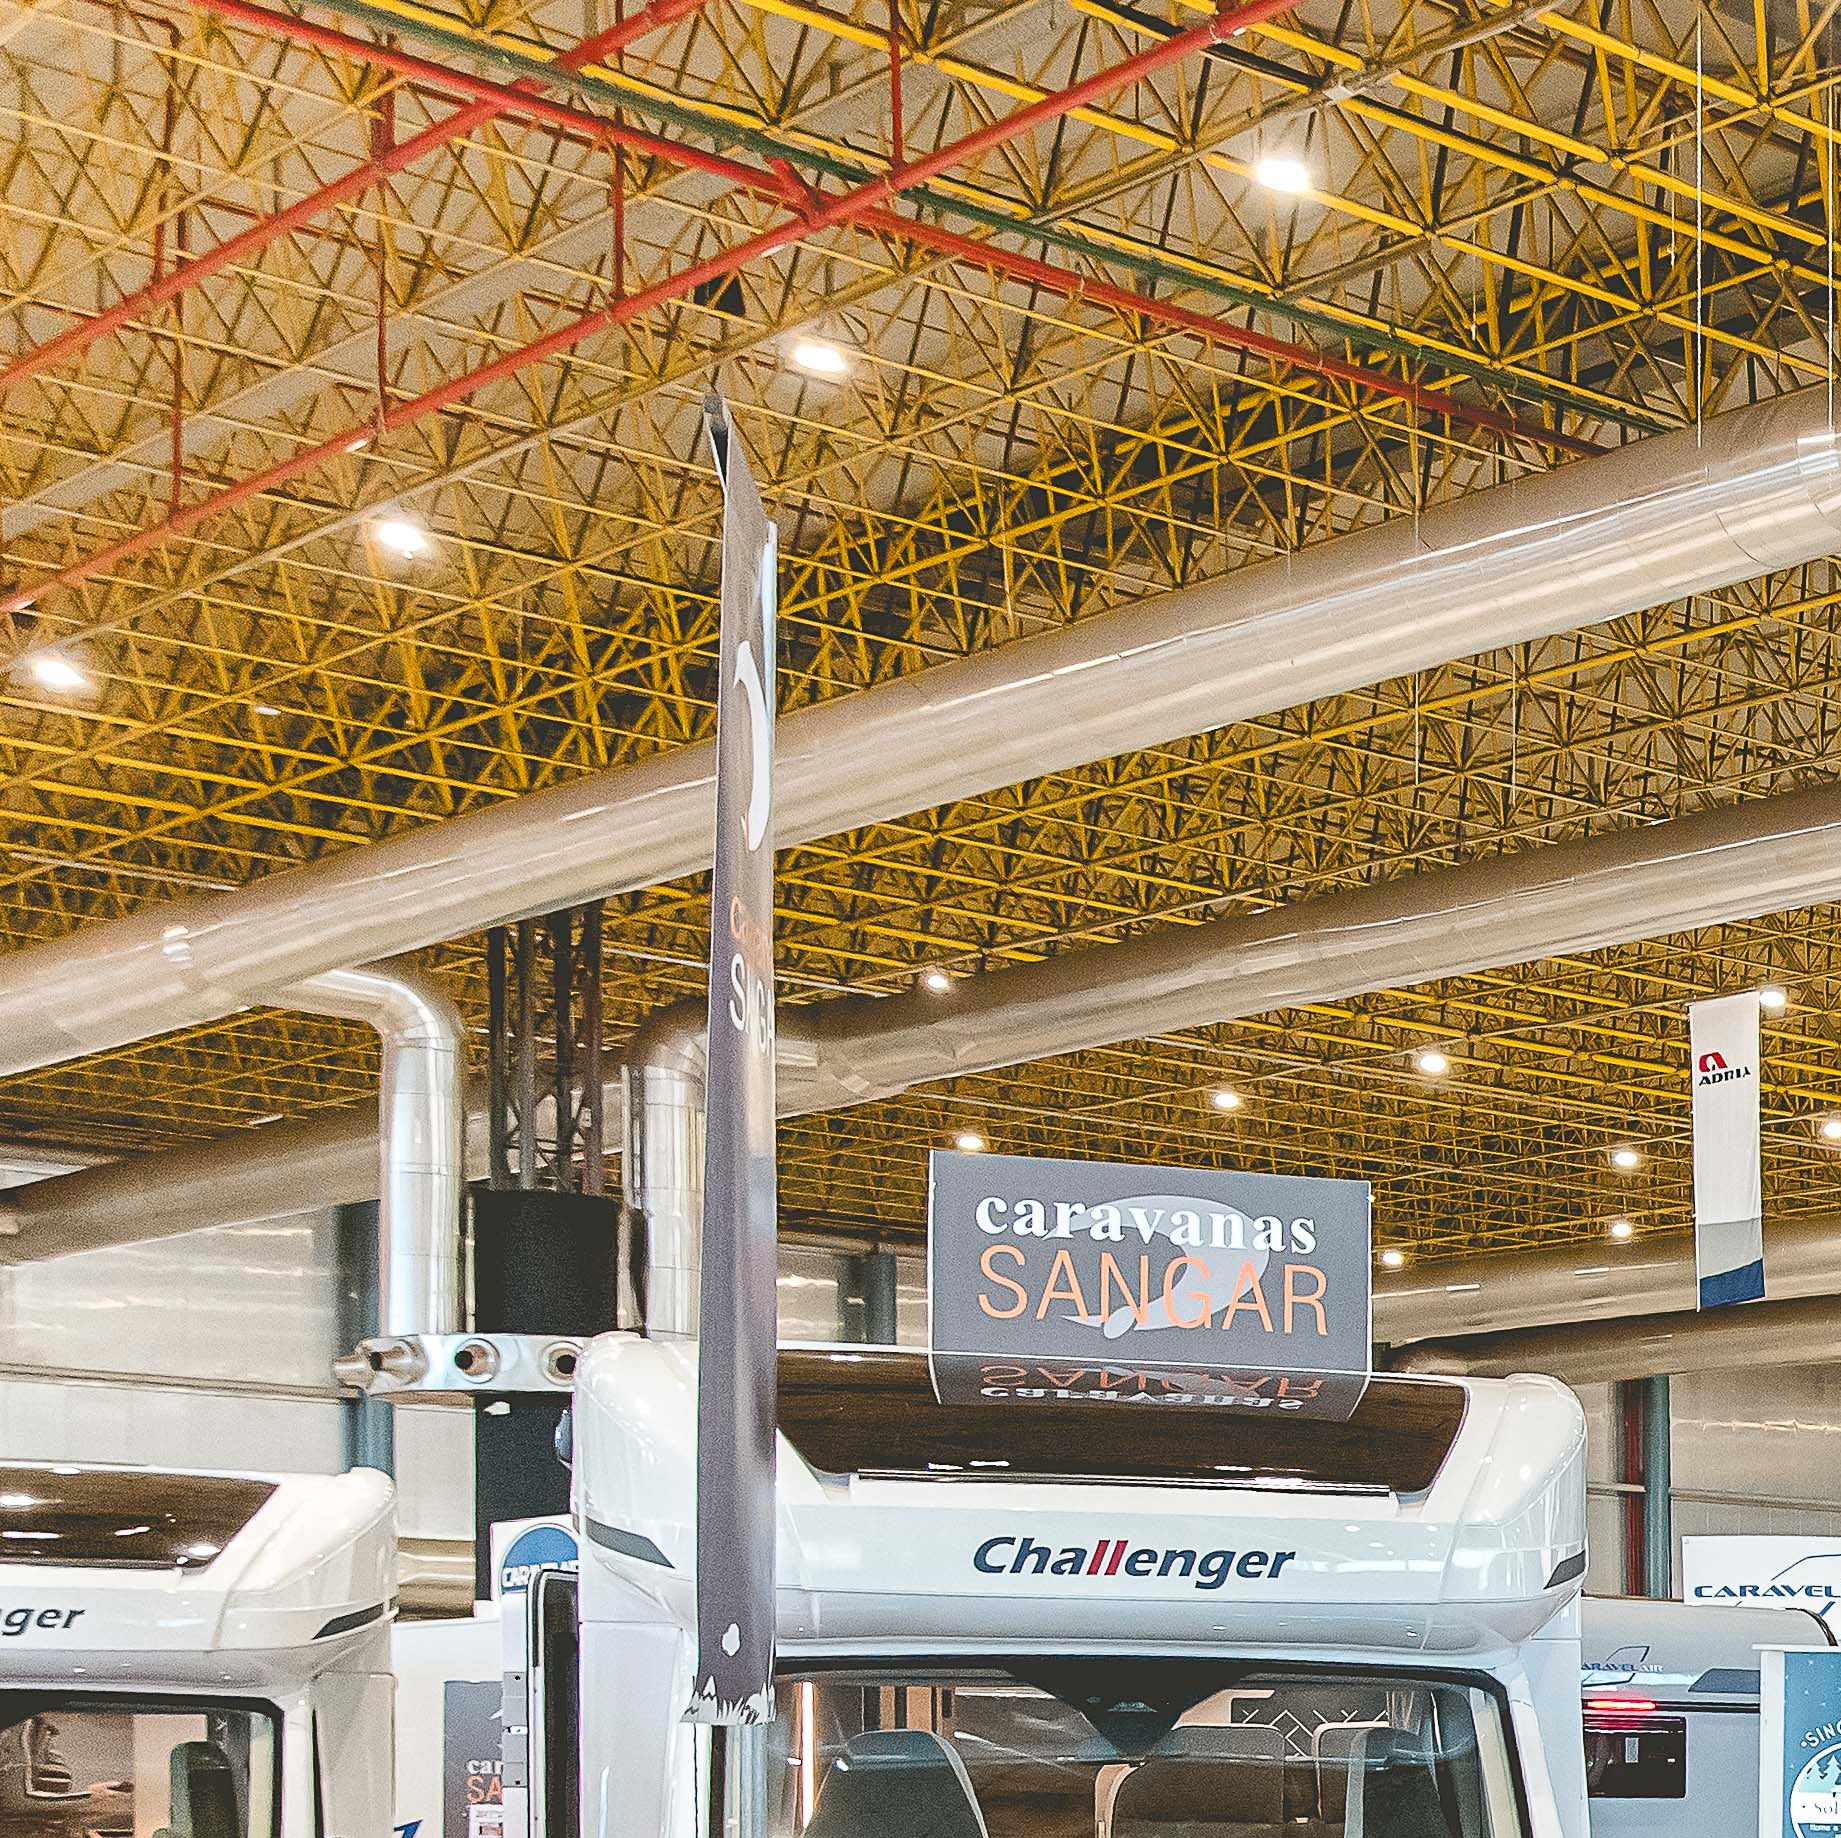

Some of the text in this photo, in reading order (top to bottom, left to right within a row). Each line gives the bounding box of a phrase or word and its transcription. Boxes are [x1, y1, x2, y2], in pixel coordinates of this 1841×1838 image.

[976, 1195, 1318, 1254] caravanas
[978, 1244, 1328, 1336] SANGAR
[972, 1537, 1296, 1589] Challenger
[1581, 1661, 1664, 1673] ARAVELAIR
[1814, 1801, 1838, 1815] Sol
